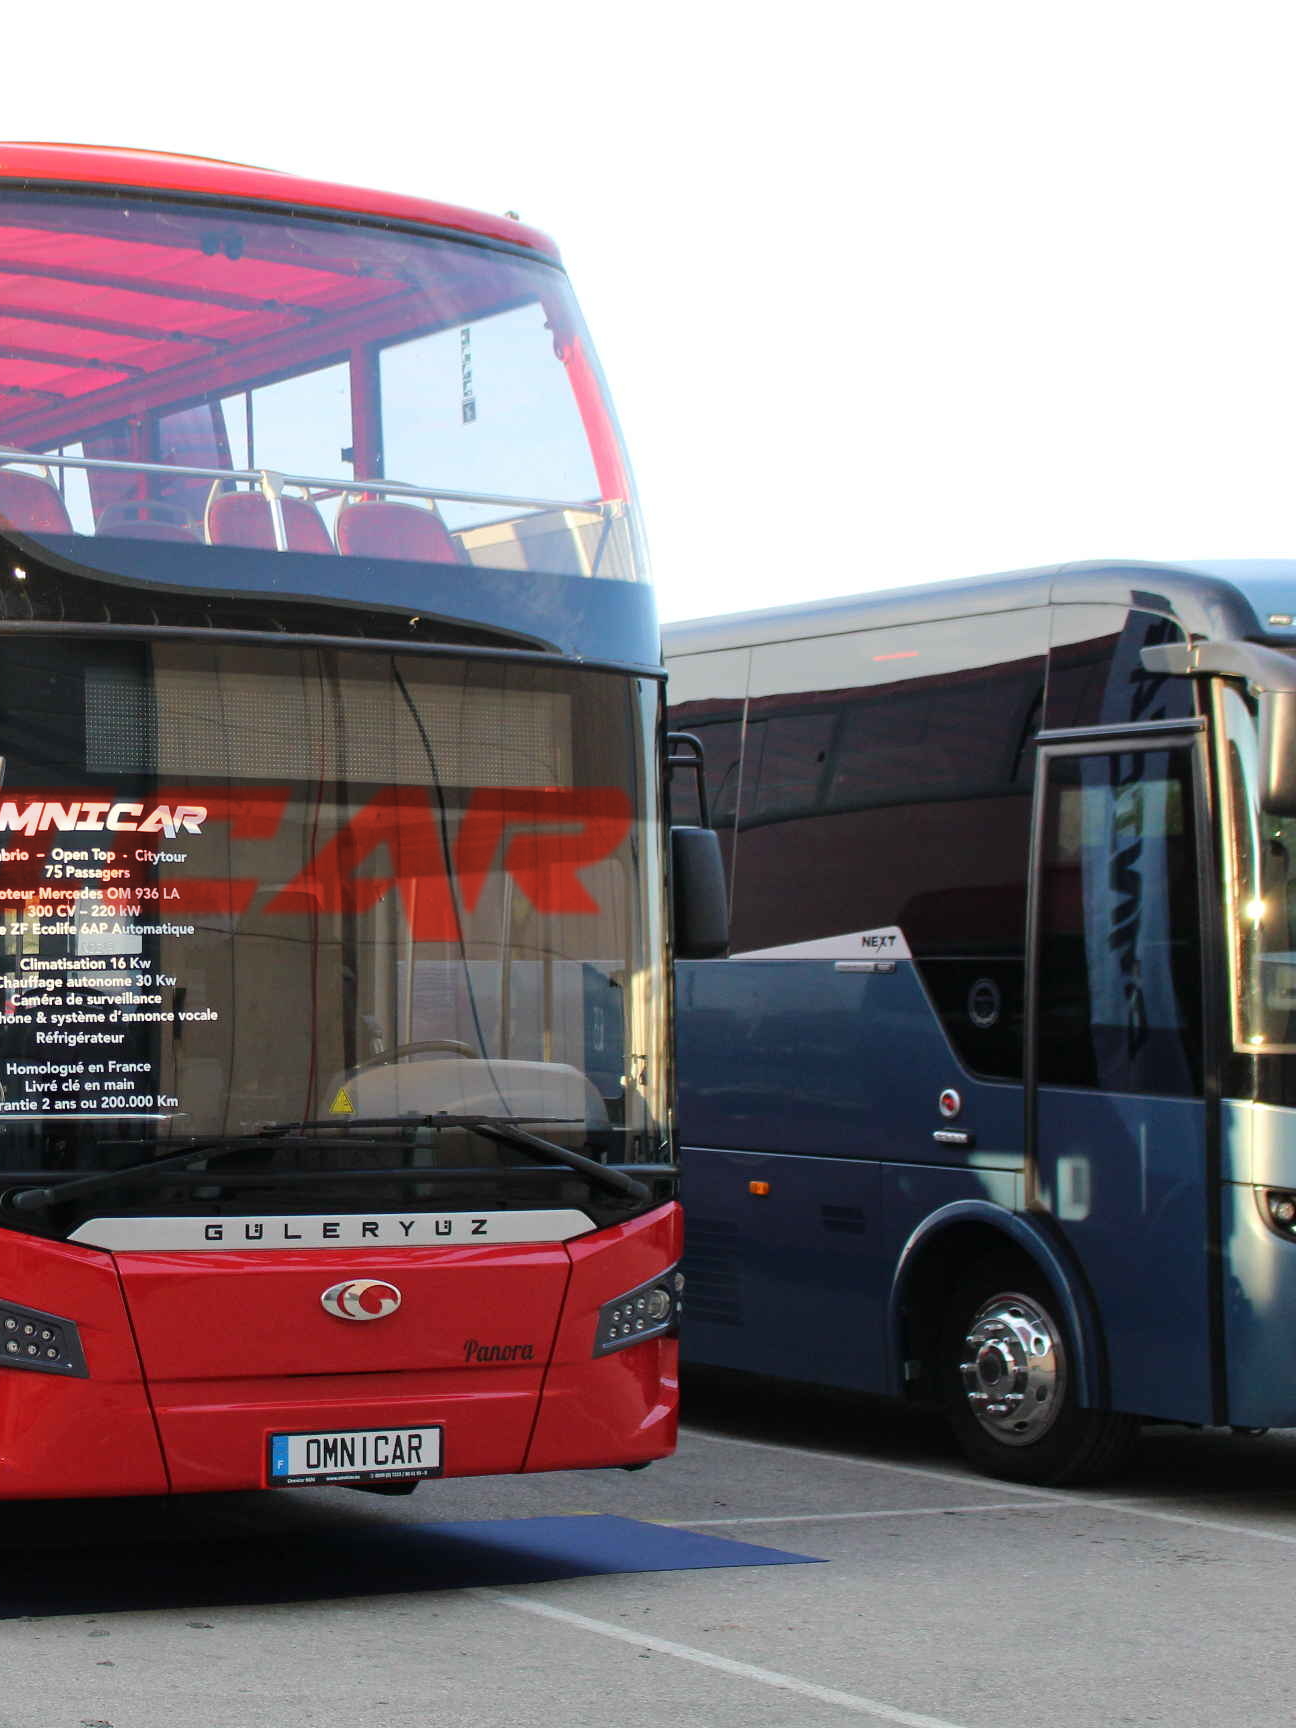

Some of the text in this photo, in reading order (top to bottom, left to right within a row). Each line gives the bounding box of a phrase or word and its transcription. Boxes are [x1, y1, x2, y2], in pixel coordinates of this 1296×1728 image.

[52, 848, 88, 864] Open
[92, 848, 115, 863] Top
[135, 850, 187, 864] Citytour
[45, 866, 131, 881] 75 Passagers
[39, 888, 103, 900] Mercedes
[107, 888, 131, 900] OM
[135, 888, 159, 899] 936
[163, 888, 180, 899] LA
[27, 906, 53, 918] 300
[56, 906, 76, 918] CV
[91, 906, 115, 917] 220
[119, 905, 141, 917] kW
[10, 923, 29, 935] ZF
[32, 923, 77, 935] Ecolife
[80, 923, 108, 935] 6AP
[112, 923, 194, 938] Automatique
[862, 936, 896, 952] NEXT
[20, 958, 151, 971] Climatisation 16 Kw
[66, 977, 132, 988] autonome
[136, 975, 152, 987] 30
[156, 975, 176, 987] Kw
[11, 992, 162, 1006] Caméra de surveillance
[36, 1012, 46, 1023] &
[51, 1012, 106, 1026] système
[178, 1009, 218, 1021] vocale
[36, 1031, 125, 1047] Réfrigérateur
[6, 1060, 151, 1078] Homologué en France
[25, 1079, 135, 1093] Livré clé en main
[42, 1099, 50, 1110] 2
[54, 1101, 76, 1110] ans
[81, 1101, 97, 1109] ou
[101, 1096, 153, 1108] 200.000
[157, 1096, 178, 1108] Km
[205, 1219, 488, 1241] GÜLERYÜZ
[464, 1339, 534, 1363] Panora
[306, 1434, 422, 1469] OMNICAR
